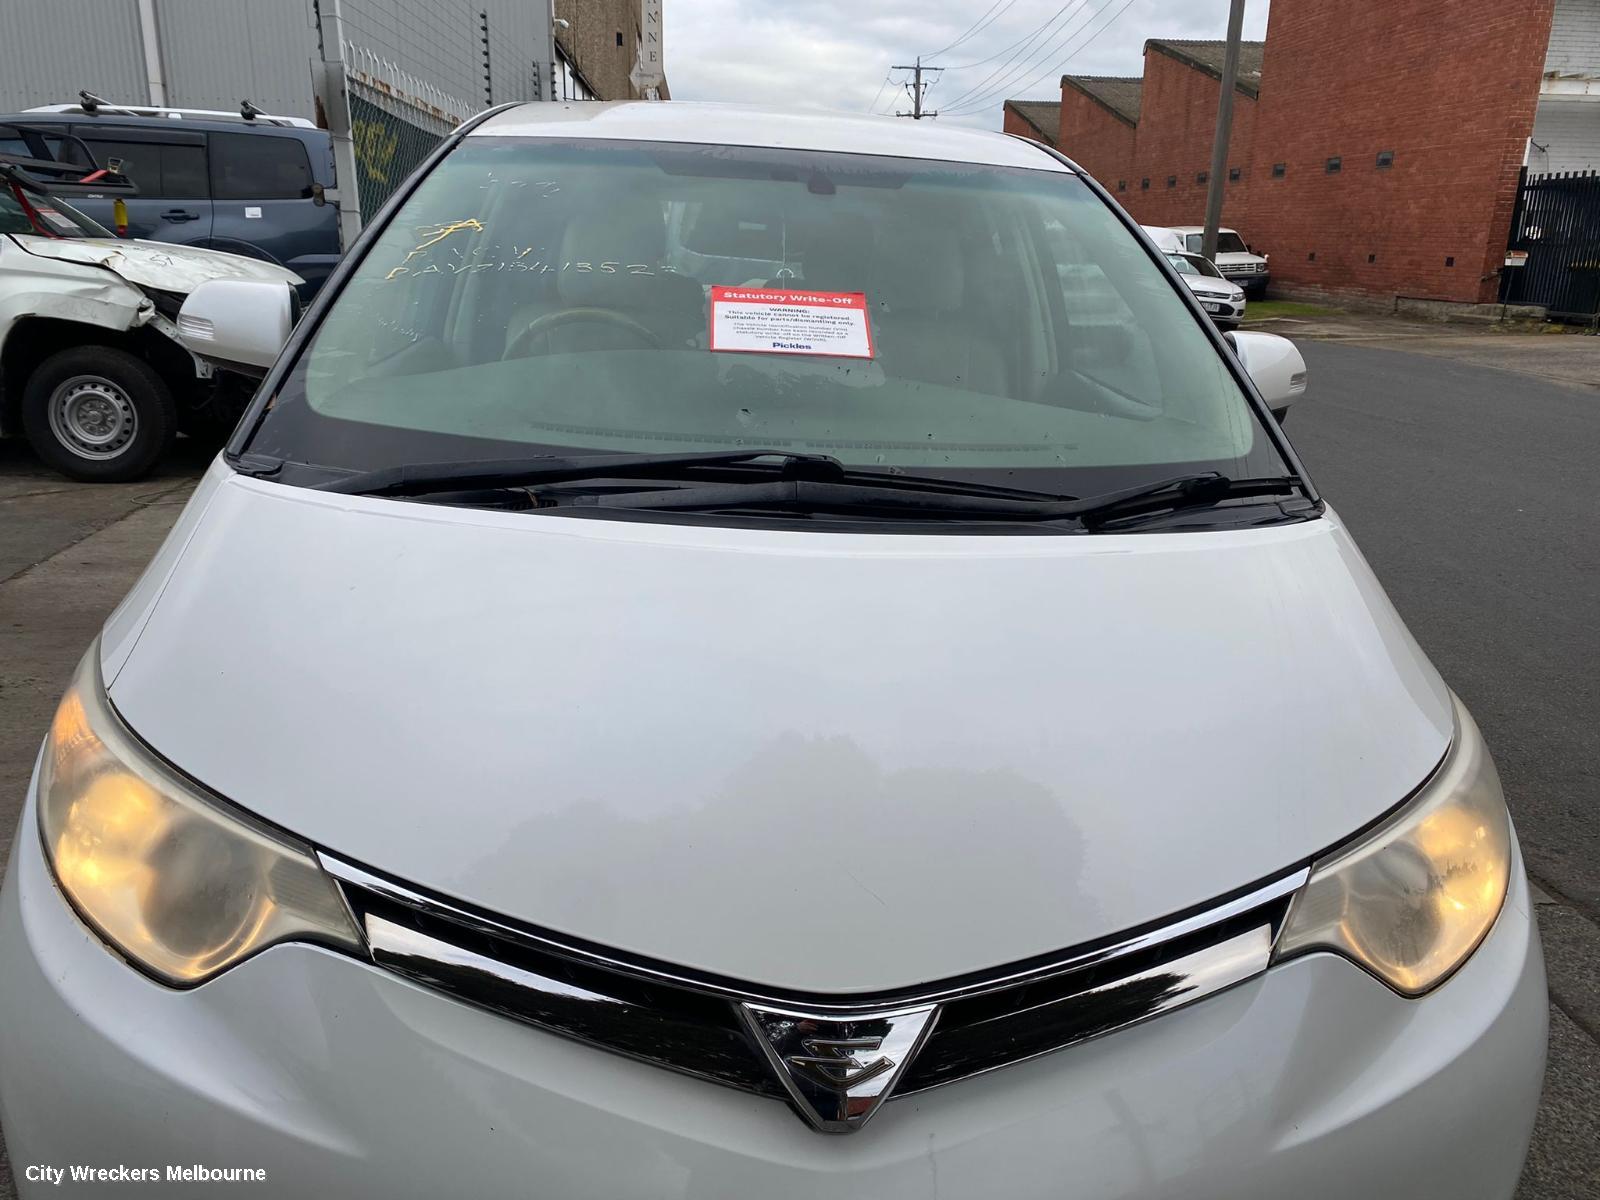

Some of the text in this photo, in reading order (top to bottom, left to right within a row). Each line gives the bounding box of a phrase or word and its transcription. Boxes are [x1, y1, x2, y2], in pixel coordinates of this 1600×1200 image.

[723, 291, 853, 304] Statutory Write-Off
[772, 341, 812, 350] Pickles
